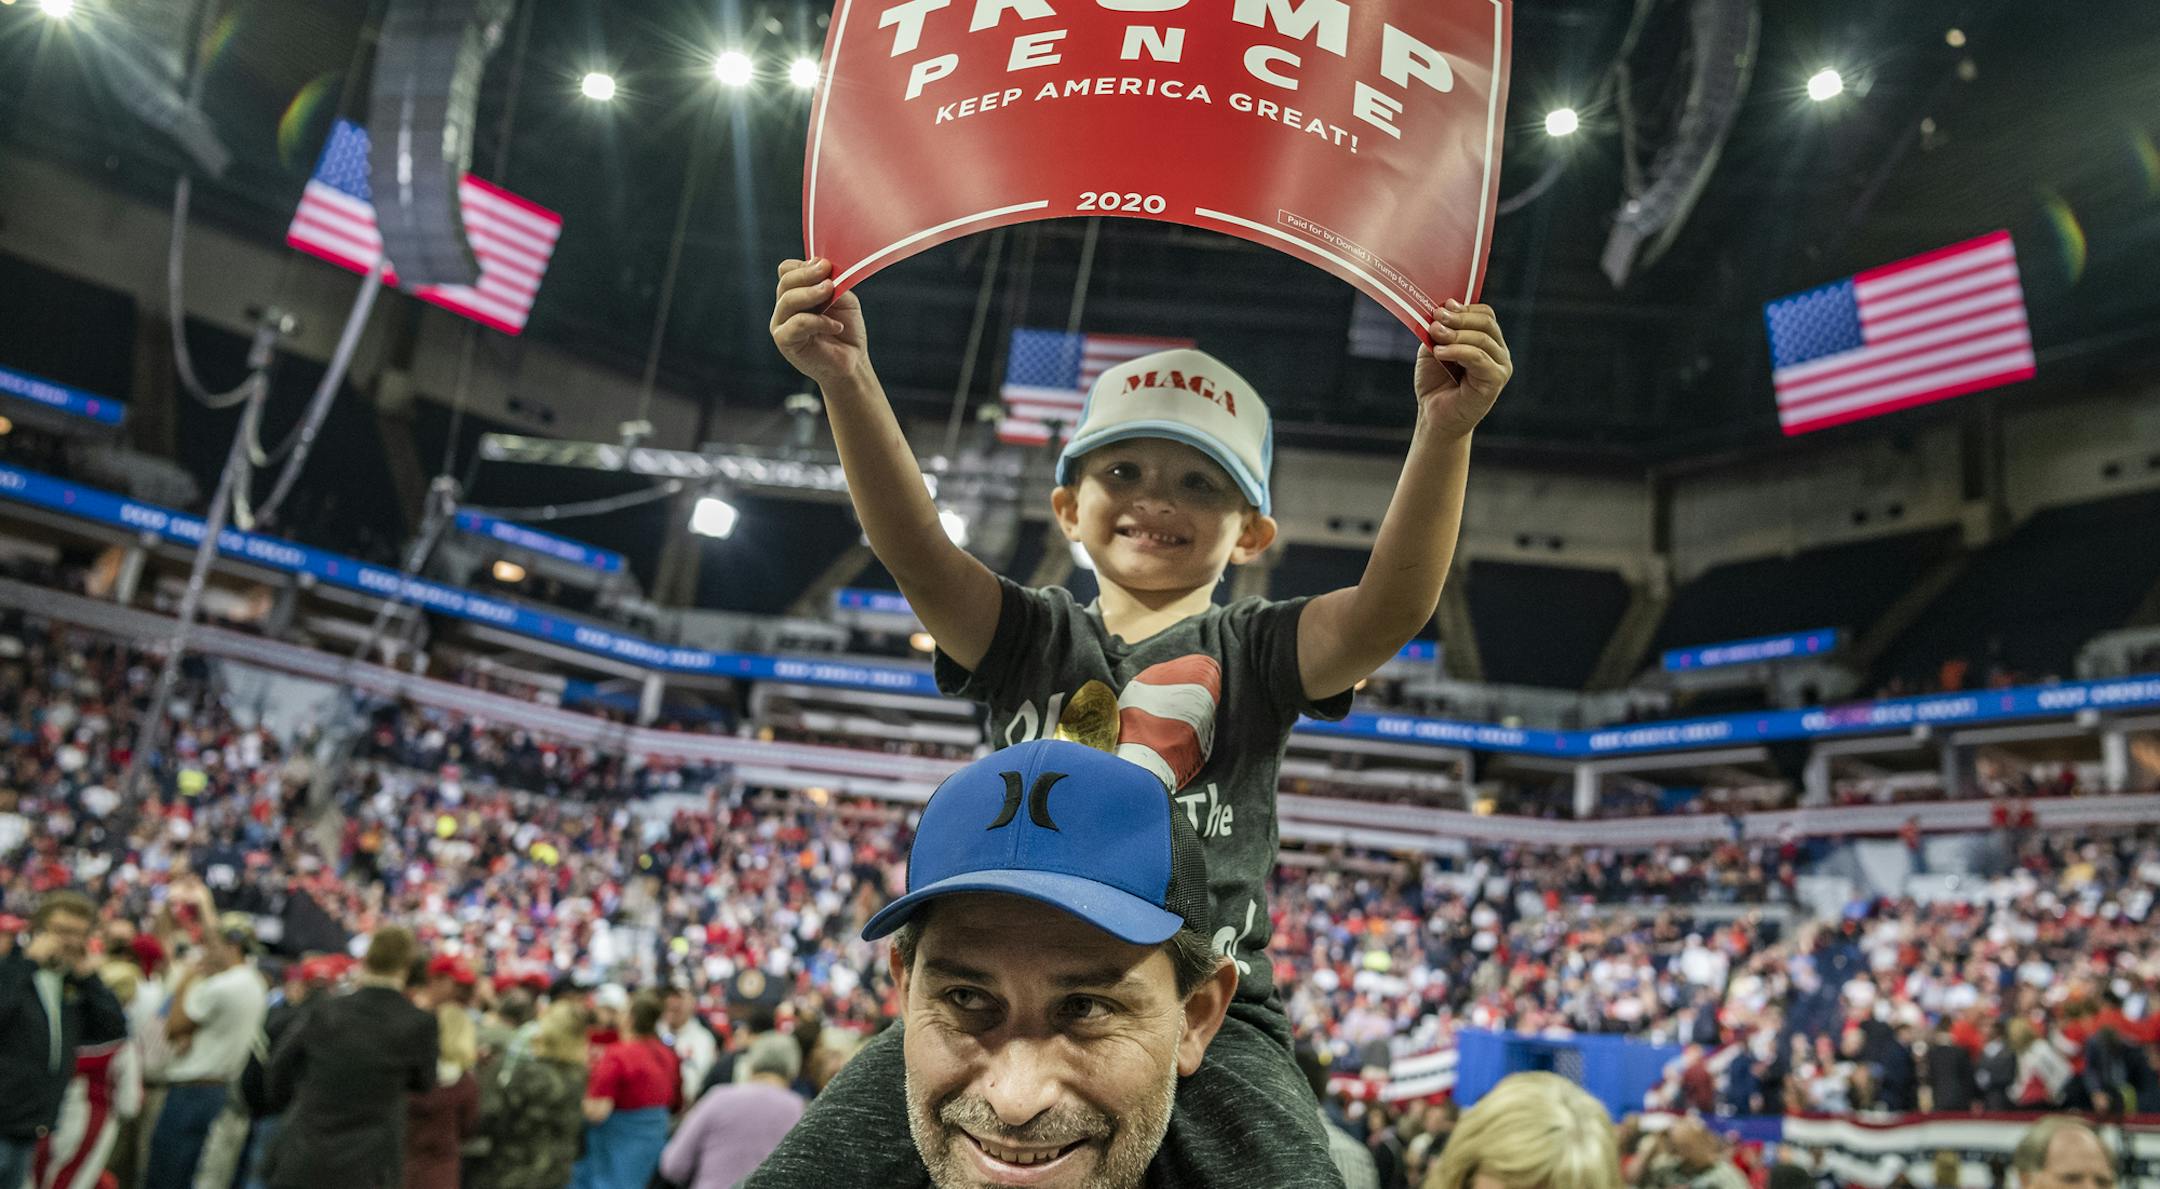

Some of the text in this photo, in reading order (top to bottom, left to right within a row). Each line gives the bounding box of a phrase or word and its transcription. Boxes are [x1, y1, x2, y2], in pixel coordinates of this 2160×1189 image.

[878, 0, 1455, 93] TRMP
[904, 25, 1403, 140] PENCE
[935, 77, 1359, 154] KEEP AMERICA GREAT!
[1076, 191, 1166, 214] 2020
[1287, 215, 1308, 230] Paid
[1309, 224, 1322, 235] for
[1323, 230, 1335, 242] by
[1336, 236, 1366, 260] Donald
[1374, 258, 1398, 282] Trump
[1398, 276, 1409, 288] for
[1408, 285, 1435, 312] Presiden
[1121, 370, 1236, 417] MAGA
[1175, 782, 1233, 838] The
